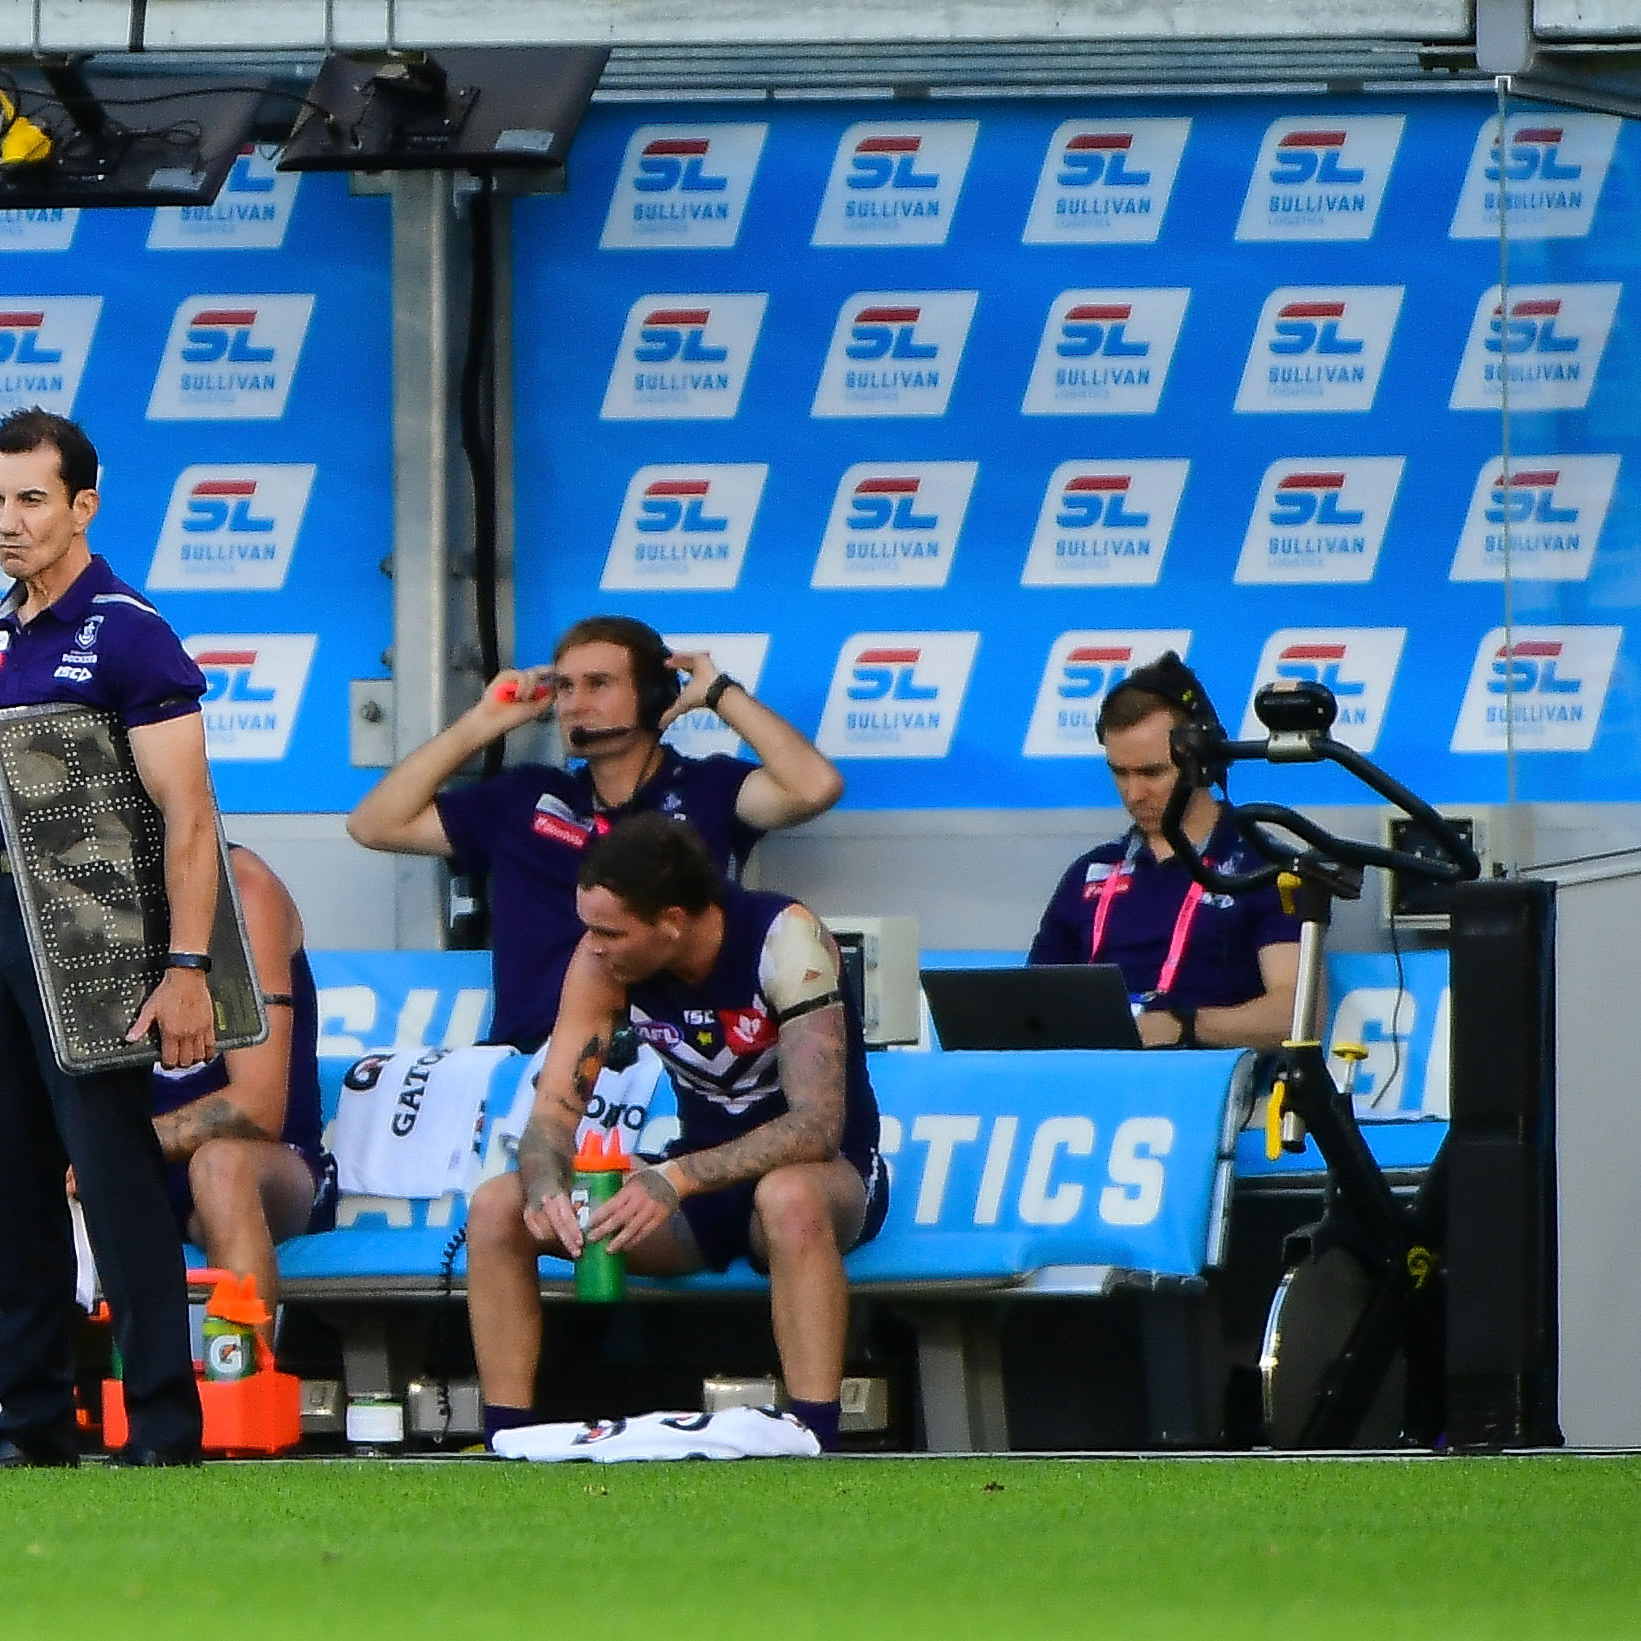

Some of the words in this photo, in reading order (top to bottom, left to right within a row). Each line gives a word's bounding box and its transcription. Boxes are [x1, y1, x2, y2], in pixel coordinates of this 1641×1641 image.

[635, 201, 728, 220] SULLIVAN
[846, 199, 939, 218] SULLIVAN
[1057, 196, 1150, 215] SULLIVAN
[1270, 194, 1363, 213] SULLIVAN
[179, 206, 272, 222] SULLIVAN
[182, 373, 275, 392] SULLIVAN
[635, 372, 728, 391] SULLIVAN
[846, 370, 939, 389] SULLIVAN
[1057, 367, 1150, 386] SULLIVAN
[1270, 364, 1363, 383] SULLIVAN
[183, 543, 276, 562] SULLIVAN
[636, 542, 729, 561] SULLIVAN
[846, 540, 939, 559] SULLIVAN
[1057, 538, 1150, 557] SULLIVAN
[1270, 536, 1363, 555] SULLIVAN
[846, 711, 939, 730] SULLIVAN
[637, 1024, 681, 1046] AFL
[391, 1050, 448, 1139] GATO
